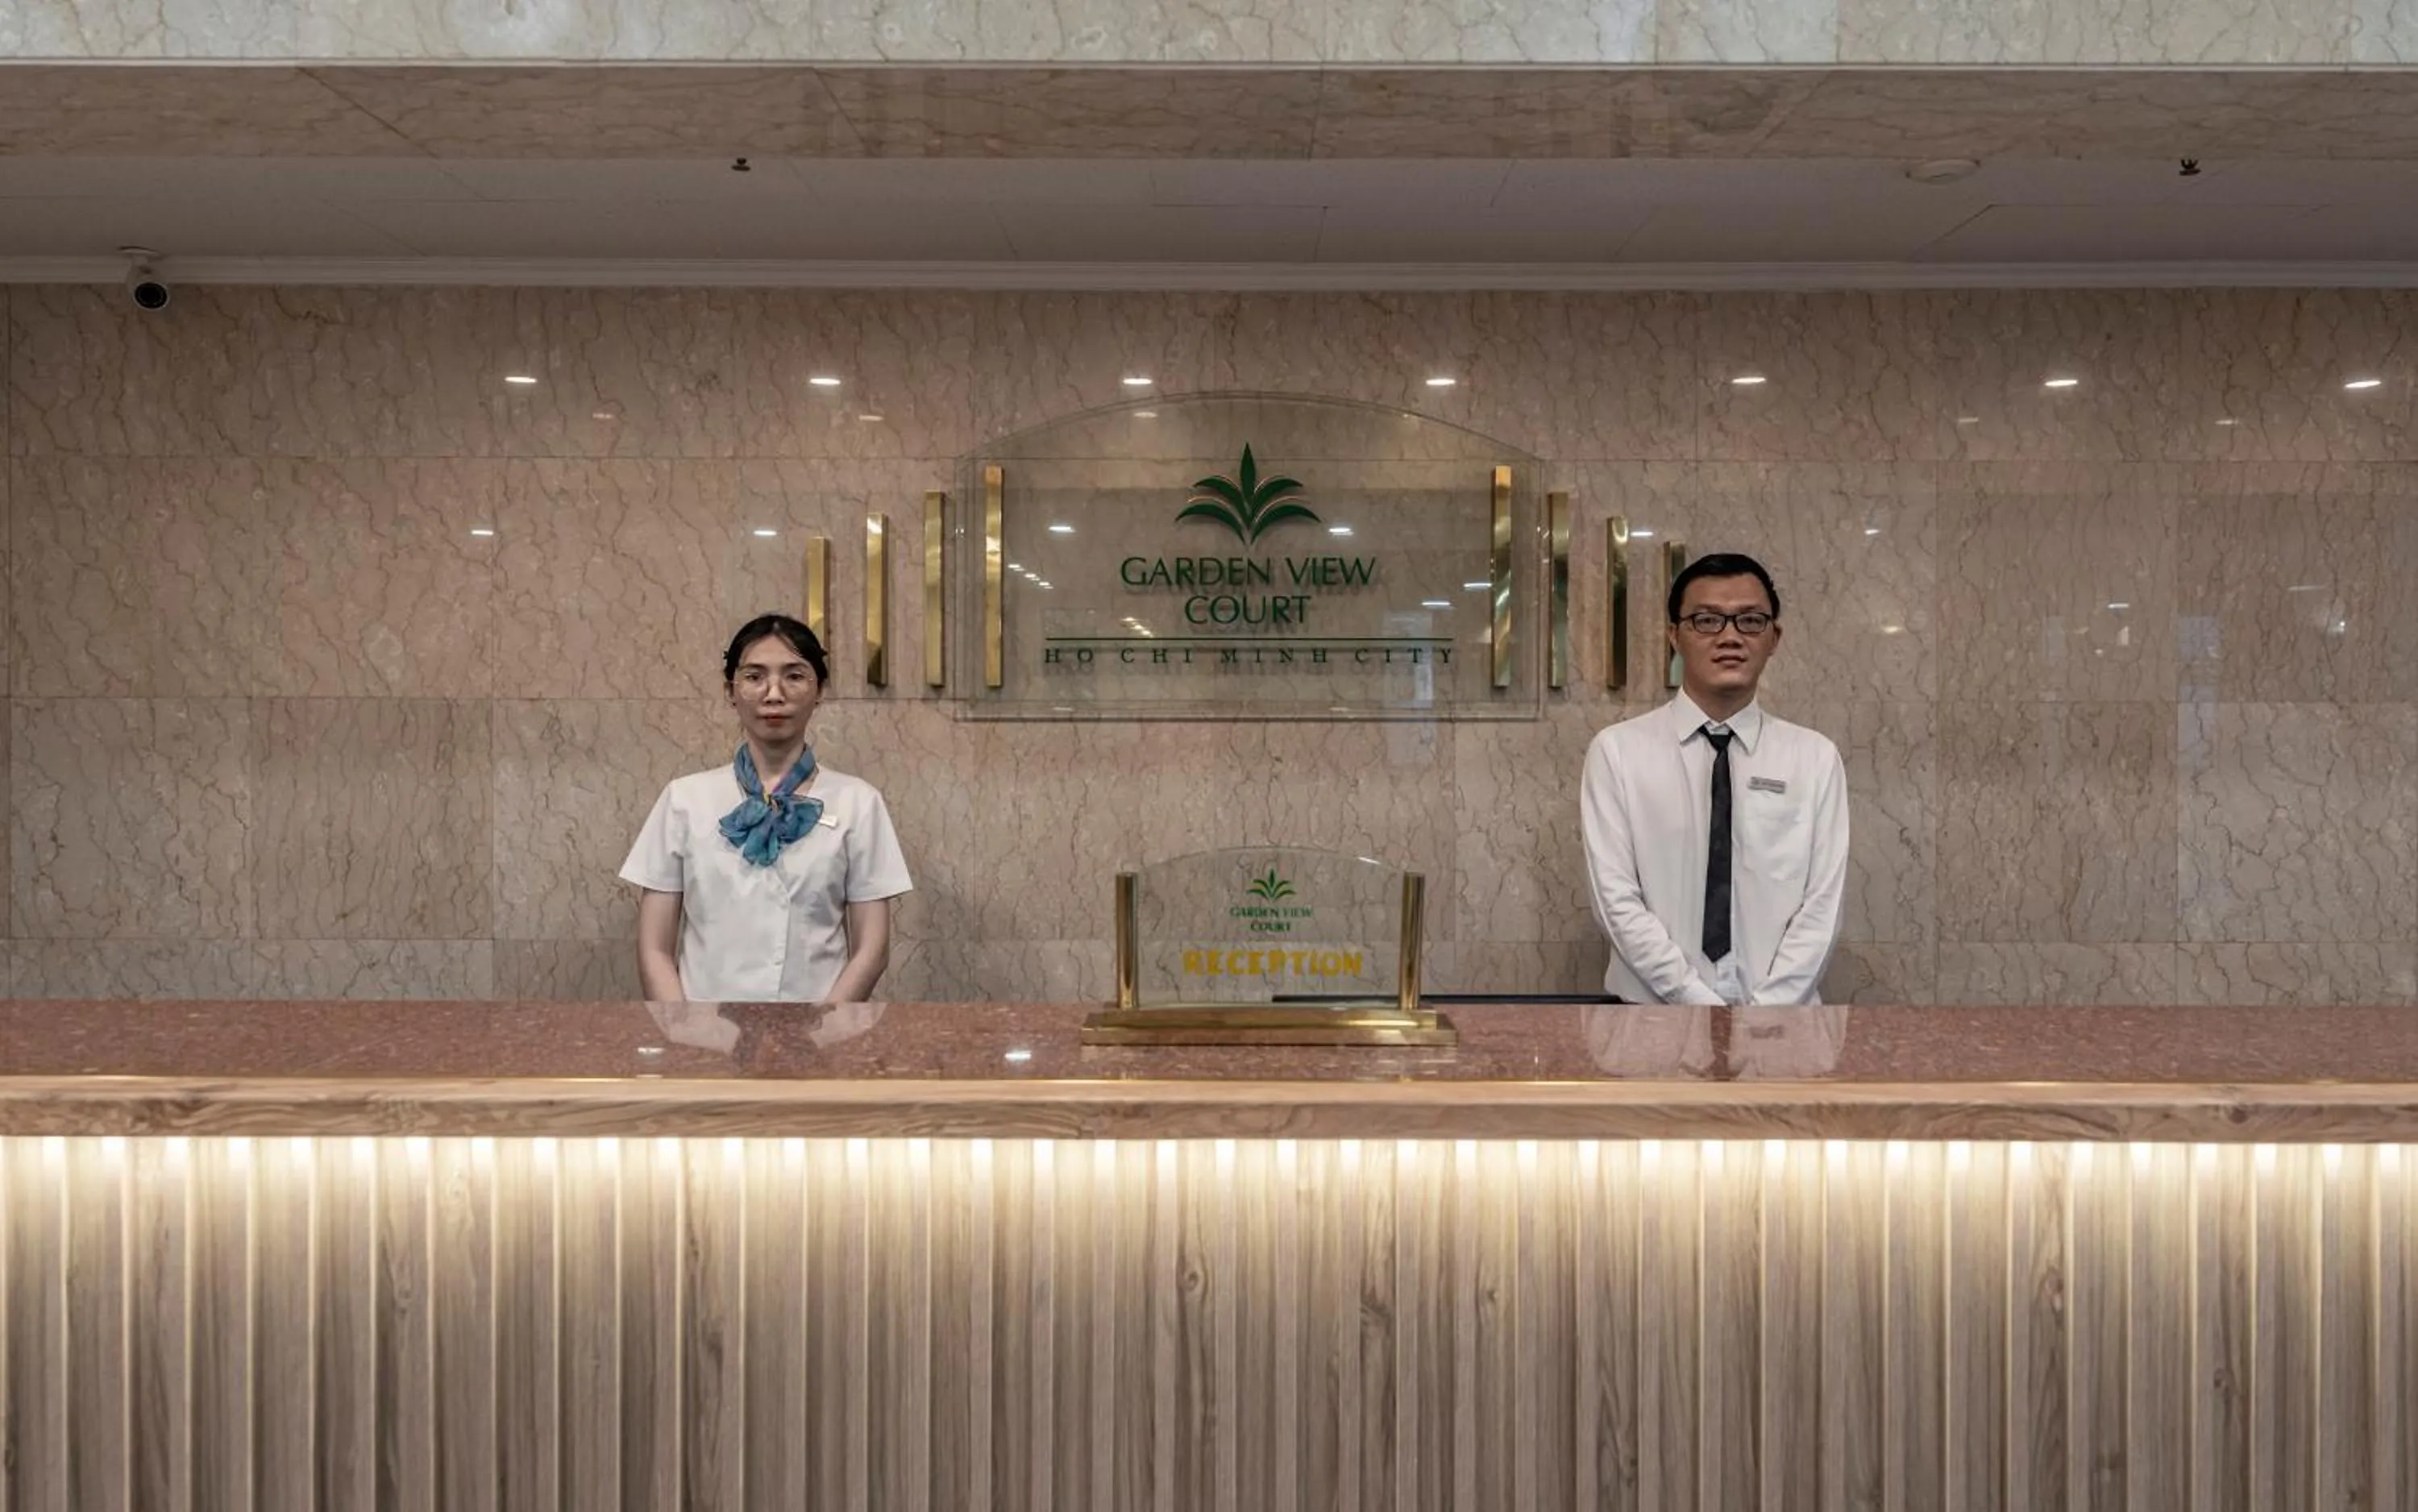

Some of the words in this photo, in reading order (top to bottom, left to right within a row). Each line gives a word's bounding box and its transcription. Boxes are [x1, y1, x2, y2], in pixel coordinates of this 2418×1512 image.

[1120, 556, 1270, 586] GARDEN
[1285, 557, 1376, 586] VIEW
[1184, 595, 1311, 625] COURT
[1045, 647, 1095, 664] HO
[1121, 647, 1193, 664] CHI
[1220, 647, 1328, 664] MINH
[1355, 647, 1452, 664] CITY
[1230, 907, 1279, 918] GARDEN
[1283, 907, 1314, 918] VIEW
[1250, 920, 1291, 932] COURT
[1183, 949, 1362, 976] RECEPTION
